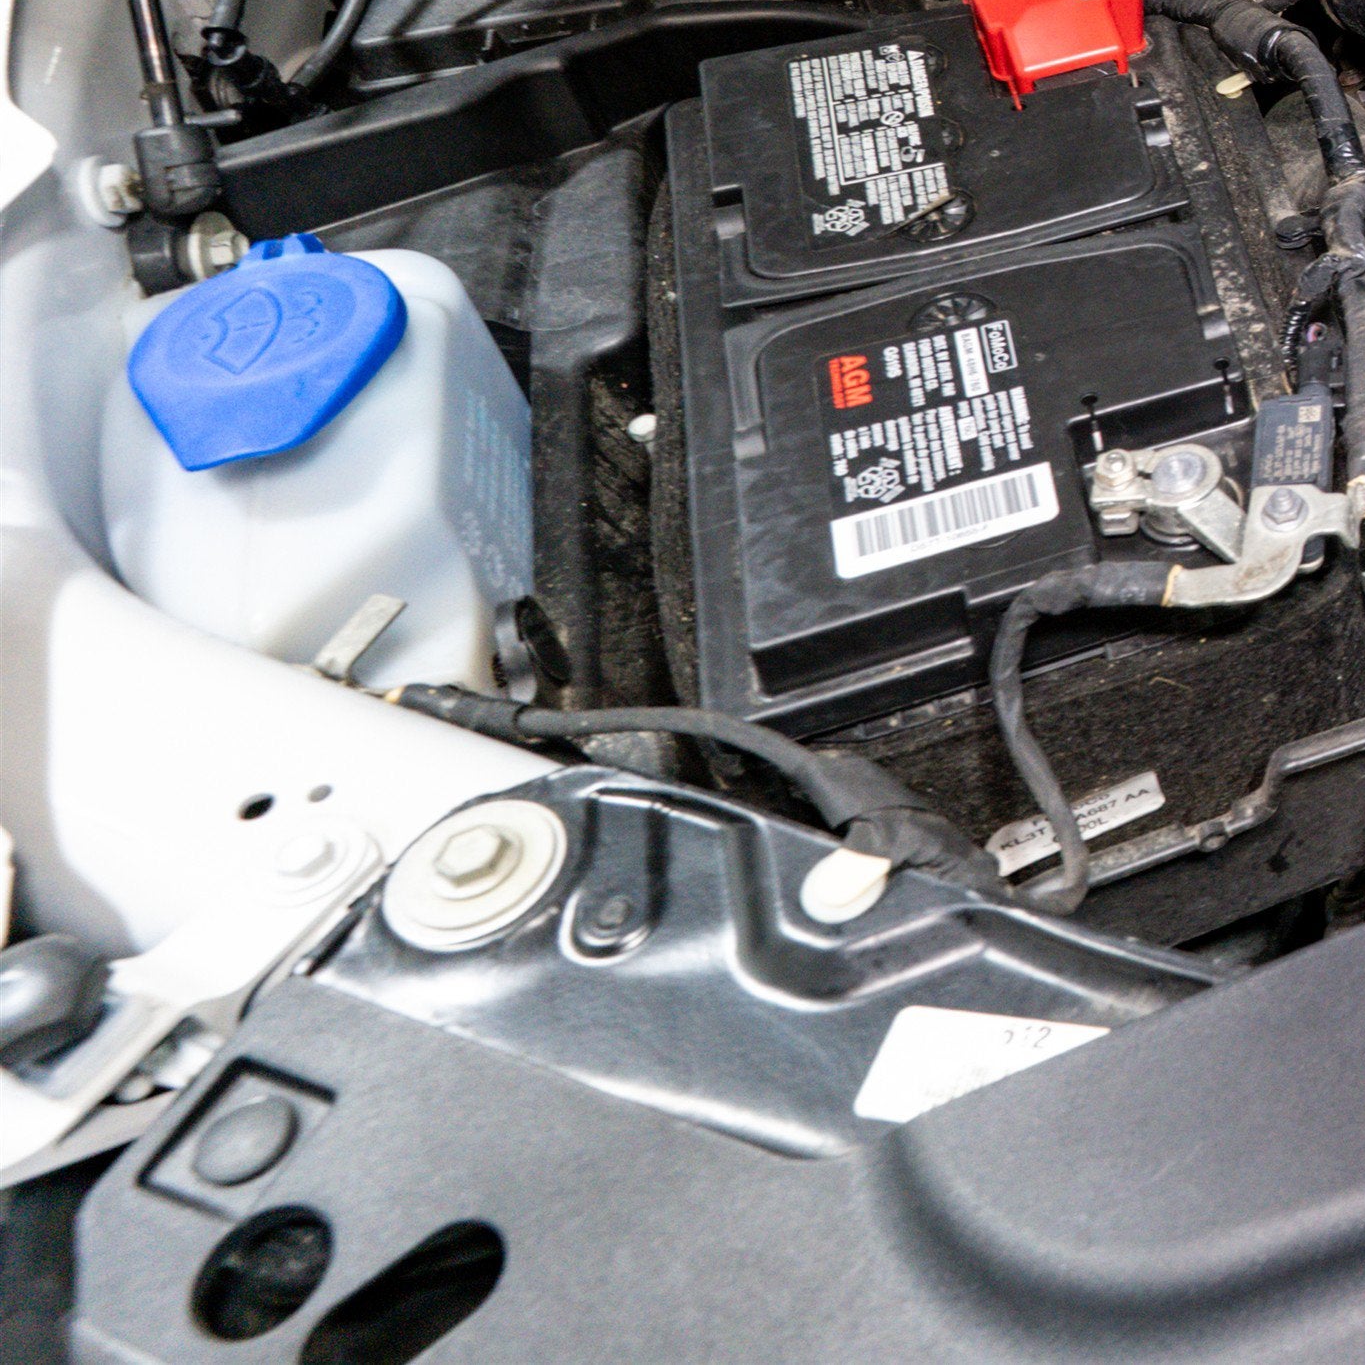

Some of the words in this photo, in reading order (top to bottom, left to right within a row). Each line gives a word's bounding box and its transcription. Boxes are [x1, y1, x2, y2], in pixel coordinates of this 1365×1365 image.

[986, 323, 1010, 370] FoMoCo
[840, 357, 872, 407] AGM
[1000, 828, 1044, 850] KL3T
